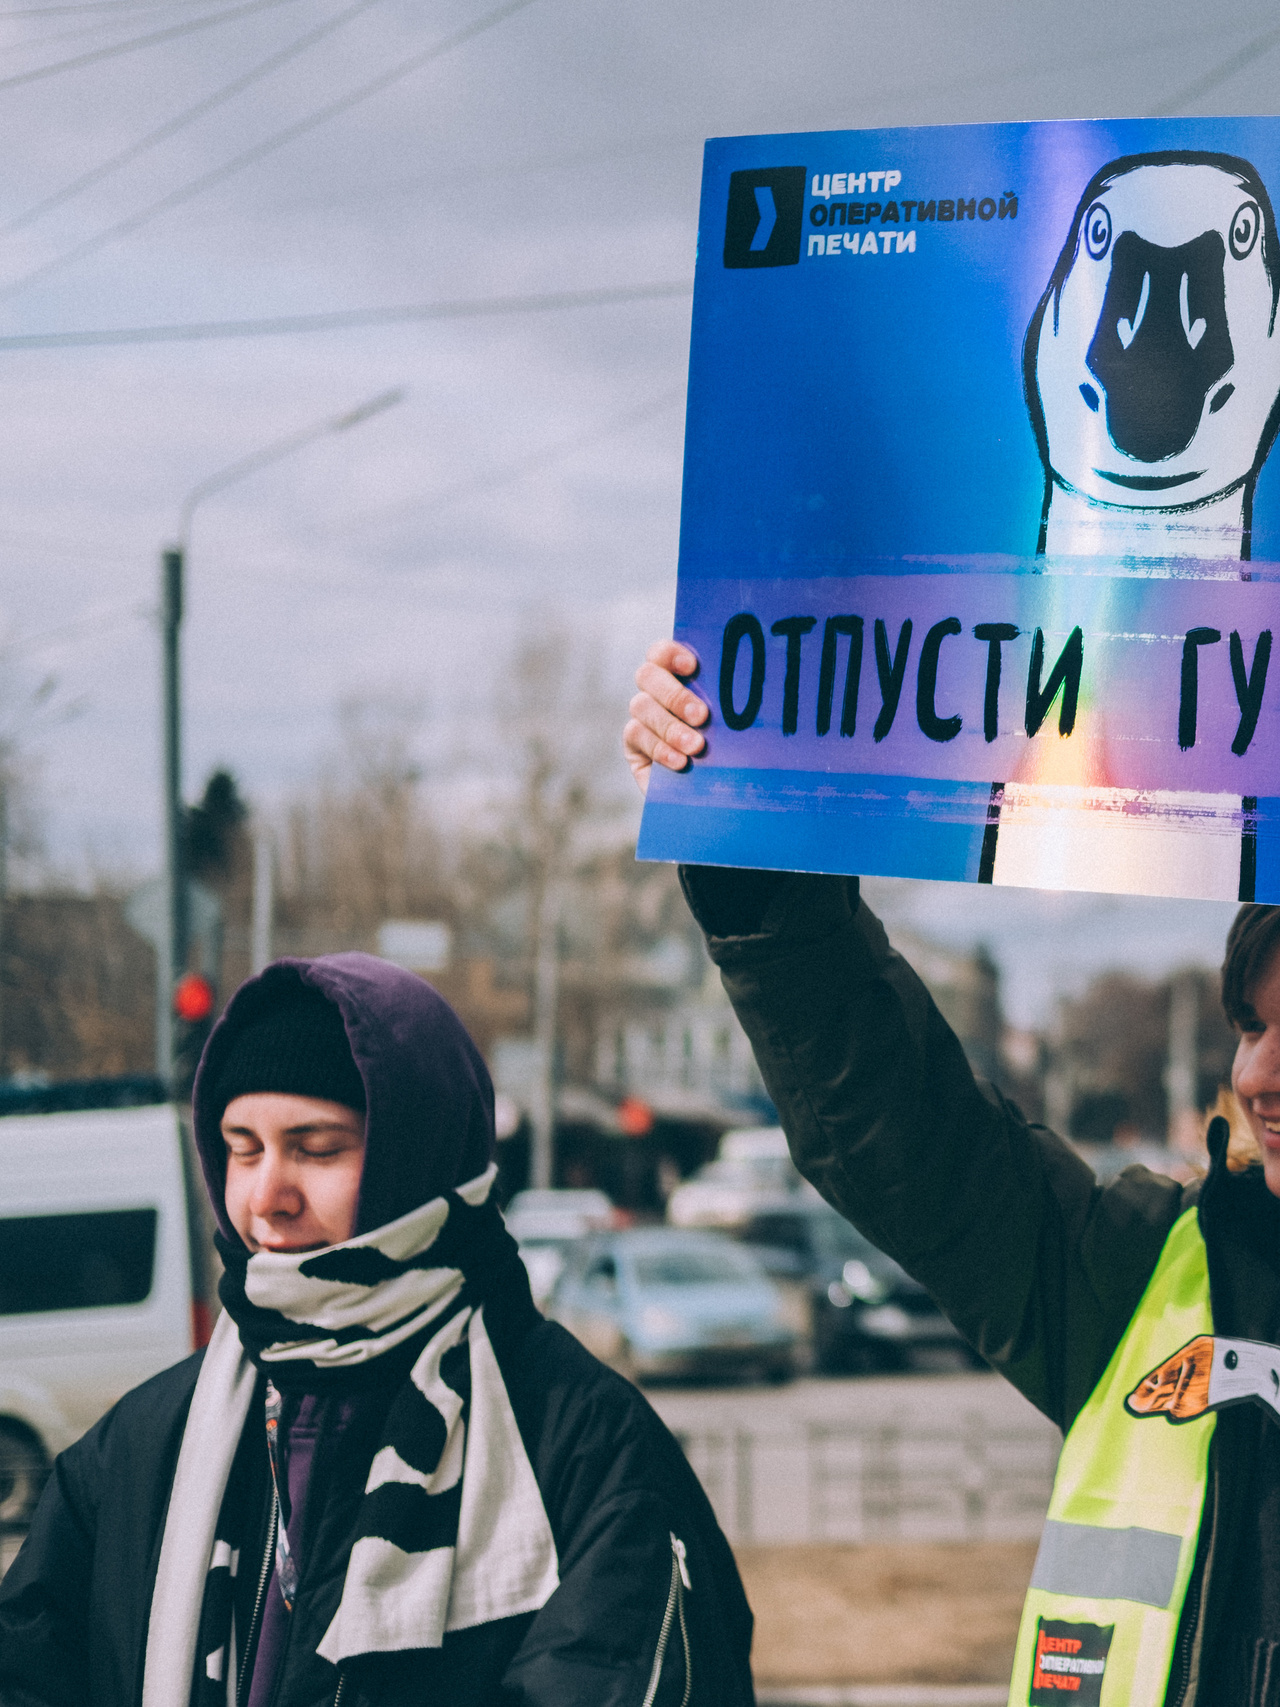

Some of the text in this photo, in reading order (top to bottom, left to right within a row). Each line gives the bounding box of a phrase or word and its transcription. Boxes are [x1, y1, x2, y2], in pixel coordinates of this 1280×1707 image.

[812, 170, 902, 199] ЦЕНТР
[810, 191, 1018, 226] ОПЕРАТИВНОЙ
[807, 230, 916, 257] ПЕЧАТИ
[718, 612, 1086, 744] ОТПУСТИ
